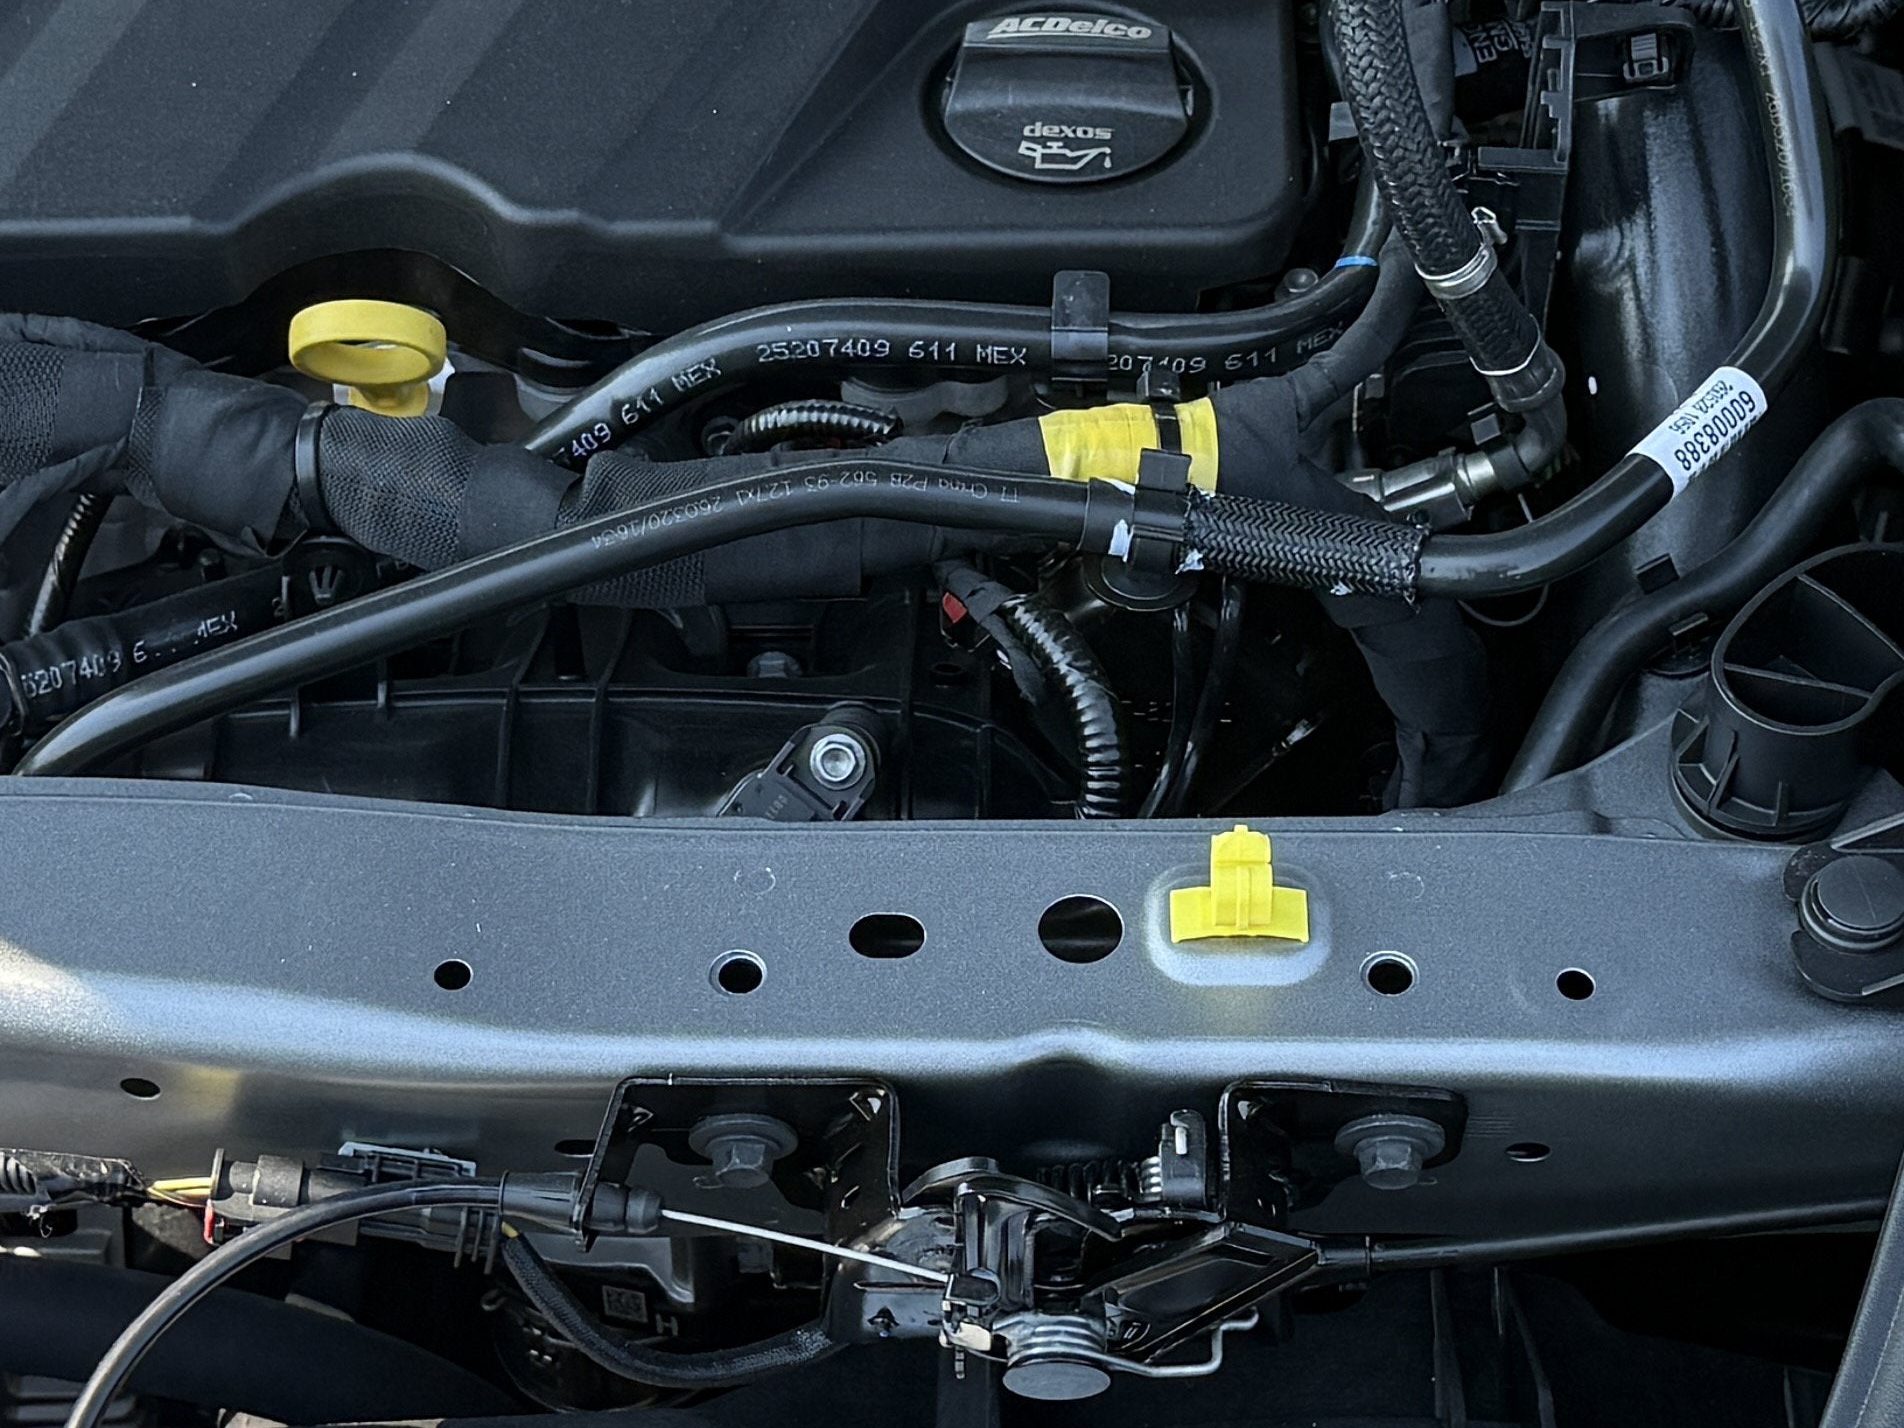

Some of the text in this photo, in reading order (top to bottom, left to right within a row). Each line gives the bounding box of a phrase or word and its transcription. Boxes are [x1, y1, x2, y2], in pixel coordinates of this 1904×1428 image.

[994, 17, 1152, 39] ACDelco
[1022, 121, 1116, 139] dexos
[622, 388, 663, 425] 611
[671, 359, 722, 392] MEX
[757, 338, 890, 363] 25207409
[907, 339, 957, 362] 611
[975, 341, 1027, 366] MEX
[1224, 346, 1278, 370] 611
[1296, 321, 1344, 355] MEX
[1675, 389, 1755, 472] 60008388
[804, 469, 878, 494] 562-93
